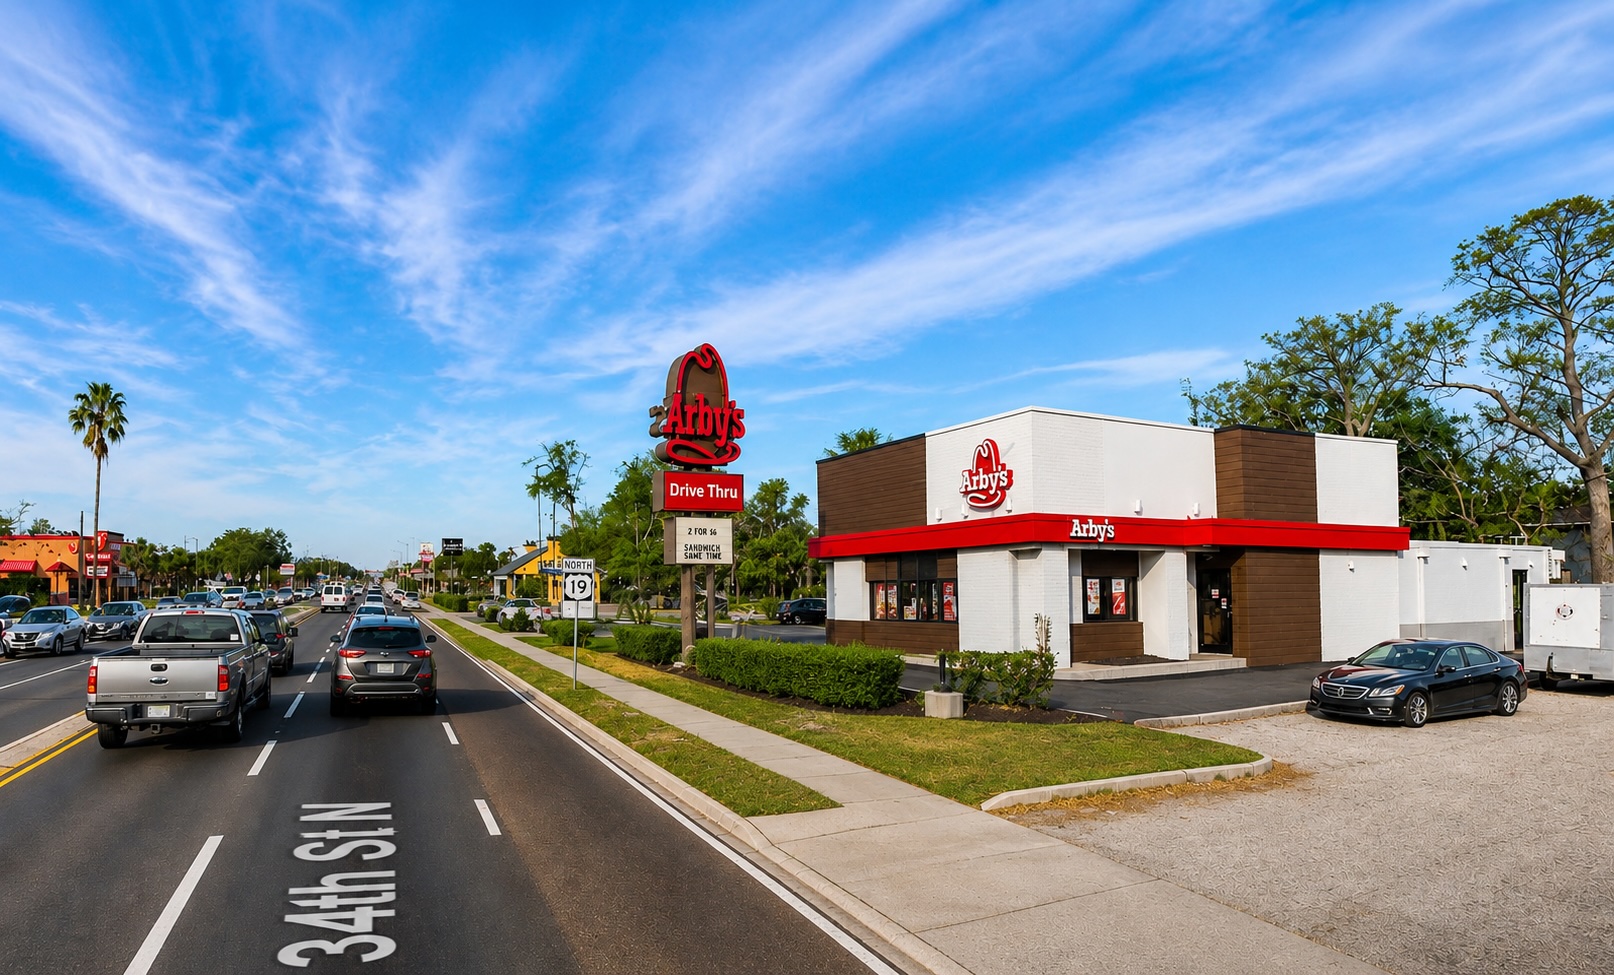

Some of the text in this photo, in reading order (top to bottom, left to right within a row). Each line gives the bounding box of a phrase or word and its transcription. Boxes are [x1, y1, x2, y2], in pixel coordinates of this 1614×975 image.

[662, 393, 746, 448] Arby's
[959, 464, 1009, 495] Arby's
[669, 483, 738, 499] Drive Thru
[687, 527, 693, 536] 2
[694, 527, 708, 536] FOR
[1069, 518, 1115, 542] Arby's
[564, 560, 593, 570] NORTH
[570, 579, 587, 594] 19
[277, 802, 398, 968] 34th St N
